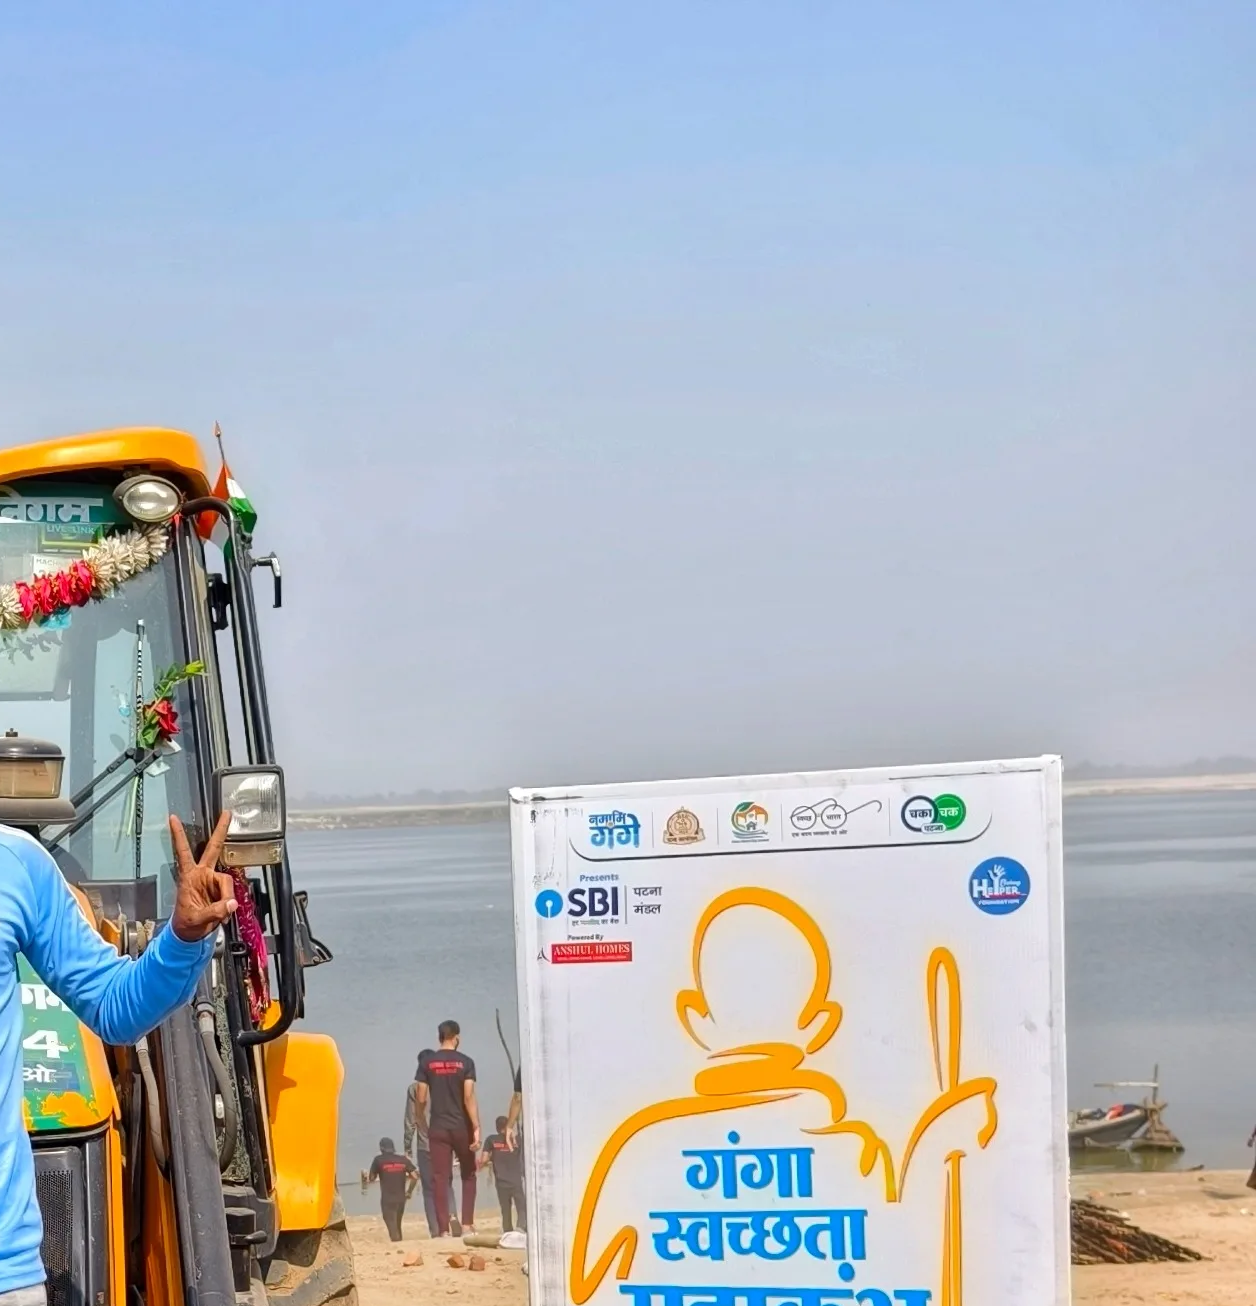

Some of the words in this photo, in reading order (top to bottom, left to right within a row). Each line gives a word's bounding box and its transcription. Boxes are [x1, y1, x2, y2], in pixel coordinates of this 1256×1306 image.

[579, 874, 619, 882] Presents
[567, 887, 618, 917] SBI
[632, 886, 662, 897] पटना
[595, 943, 630, 955] HOMES
[682, 1131, 814, 1199] गंगा
[648, 1209, 868, 1262] स्वच्छता
